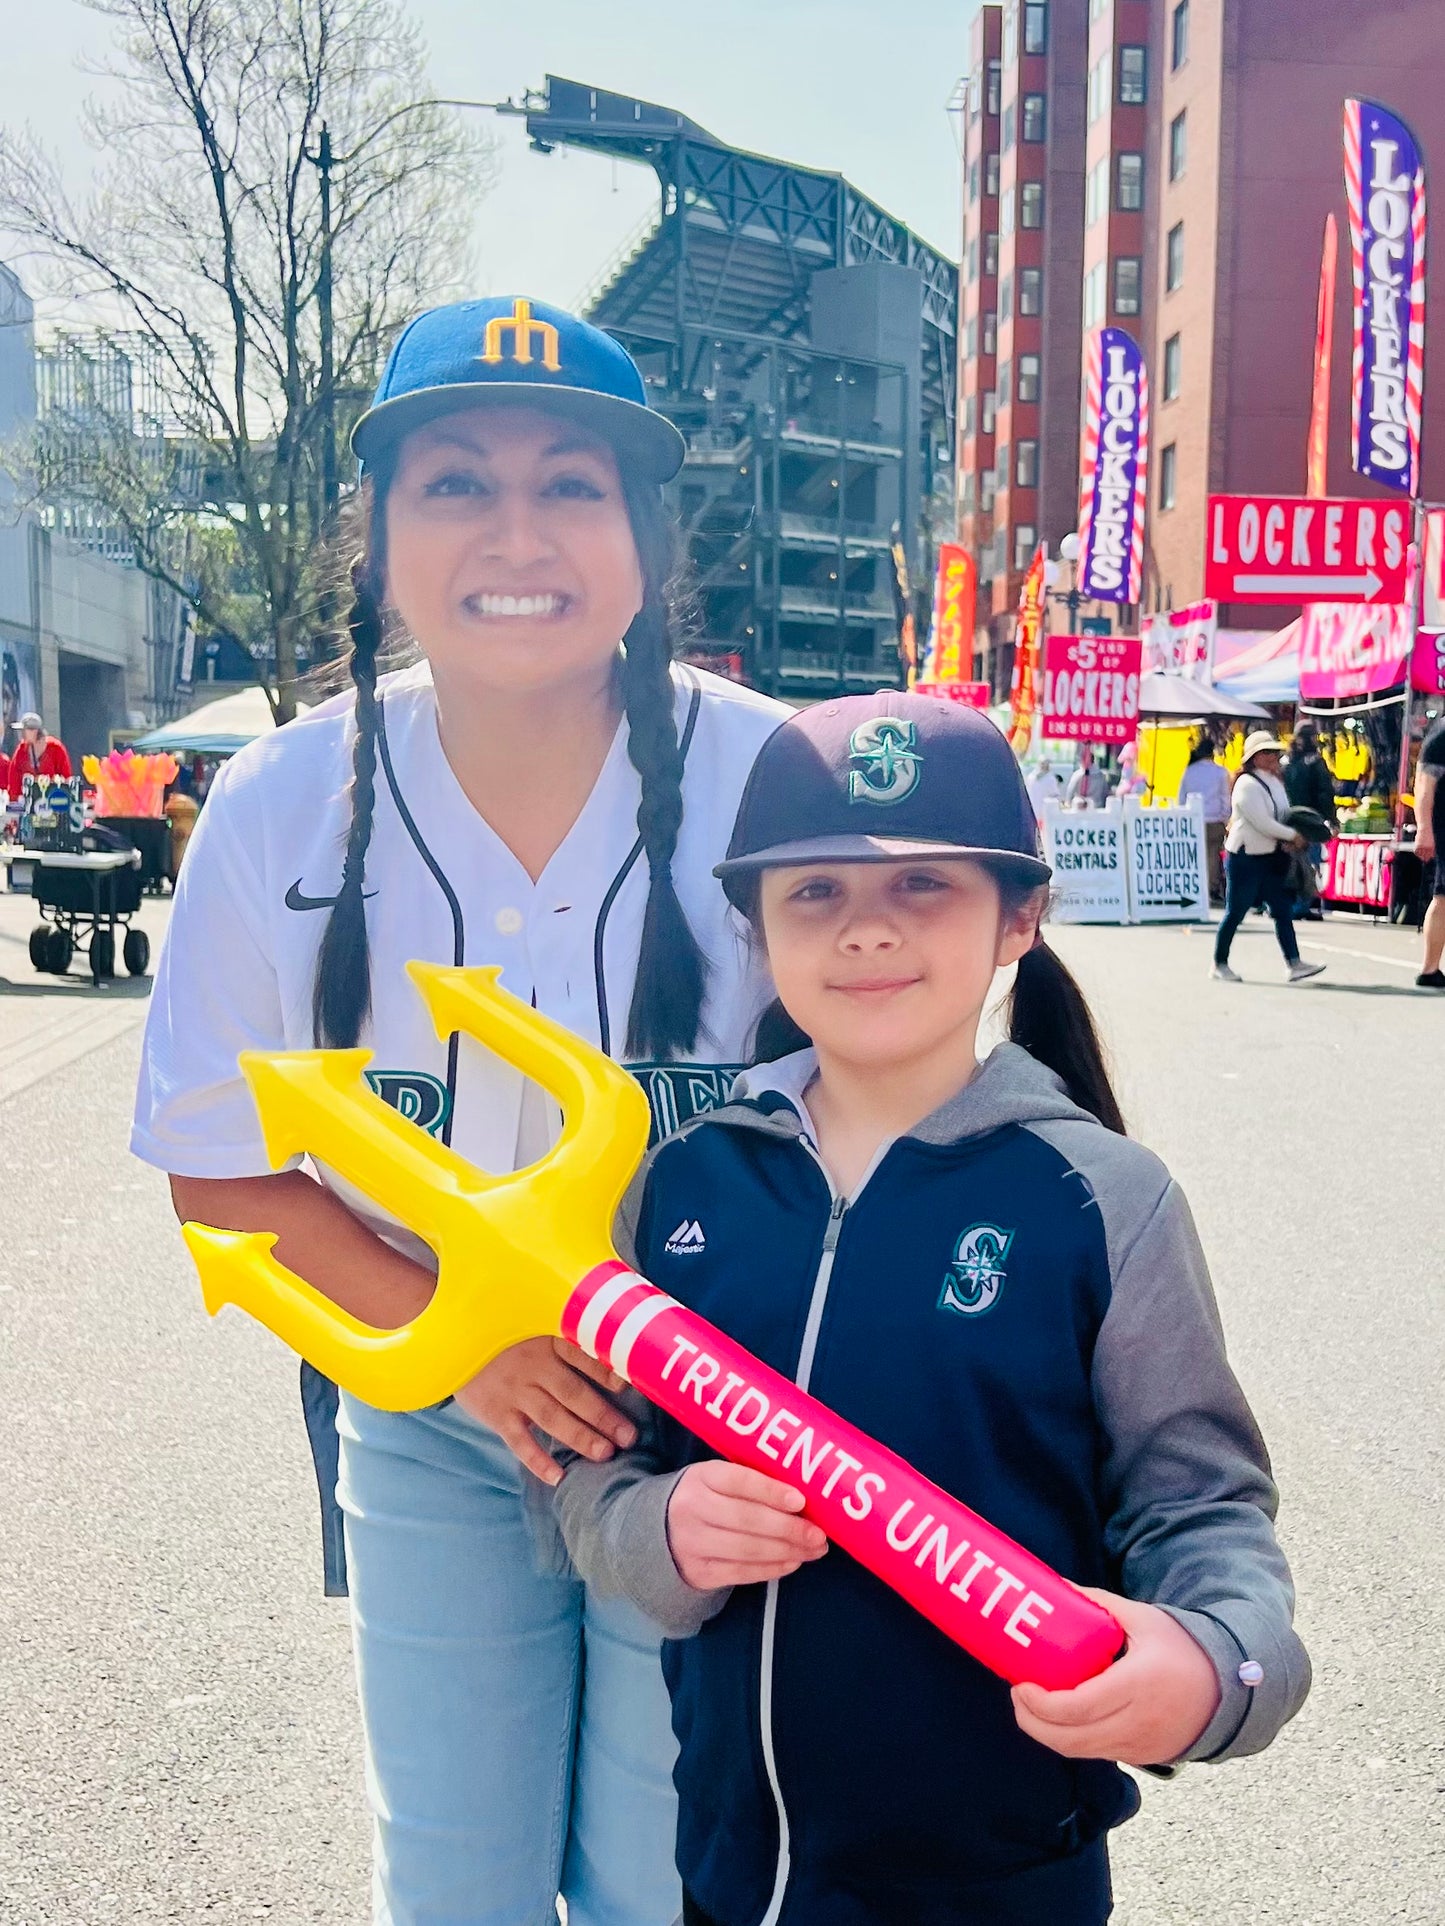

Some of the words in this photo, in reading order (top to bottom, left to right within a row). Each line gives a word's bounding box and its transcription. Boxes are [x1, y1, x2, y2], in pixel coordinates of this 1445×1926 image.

[1368, 139, 1410, 471] LOCKERS
[1090, 346, 1136, 590] LOCKERS
[1213, 503, 1402, 570] LOCKERS
[1067, 639, 1098, 669] $5
[1043, 669, 1138, 719] LOCKERS
[1048, 721, 1126, 737] INSURED
[1055, 828, 1117, 847] LOCKER
[1134, 817, 1197, 839] OFFICIAL
[1055, 852, 1117, 870] RENTALS
[1136, 842, 1198, 870] STADIUM
[1137, 873, 1200, 895] LOCKERS
[665, 1241, 705, 1255] Majestic
[659, 1334, 887, 1521] TRIDENTS
[885, 1500, 1054, 1647] UNITE
